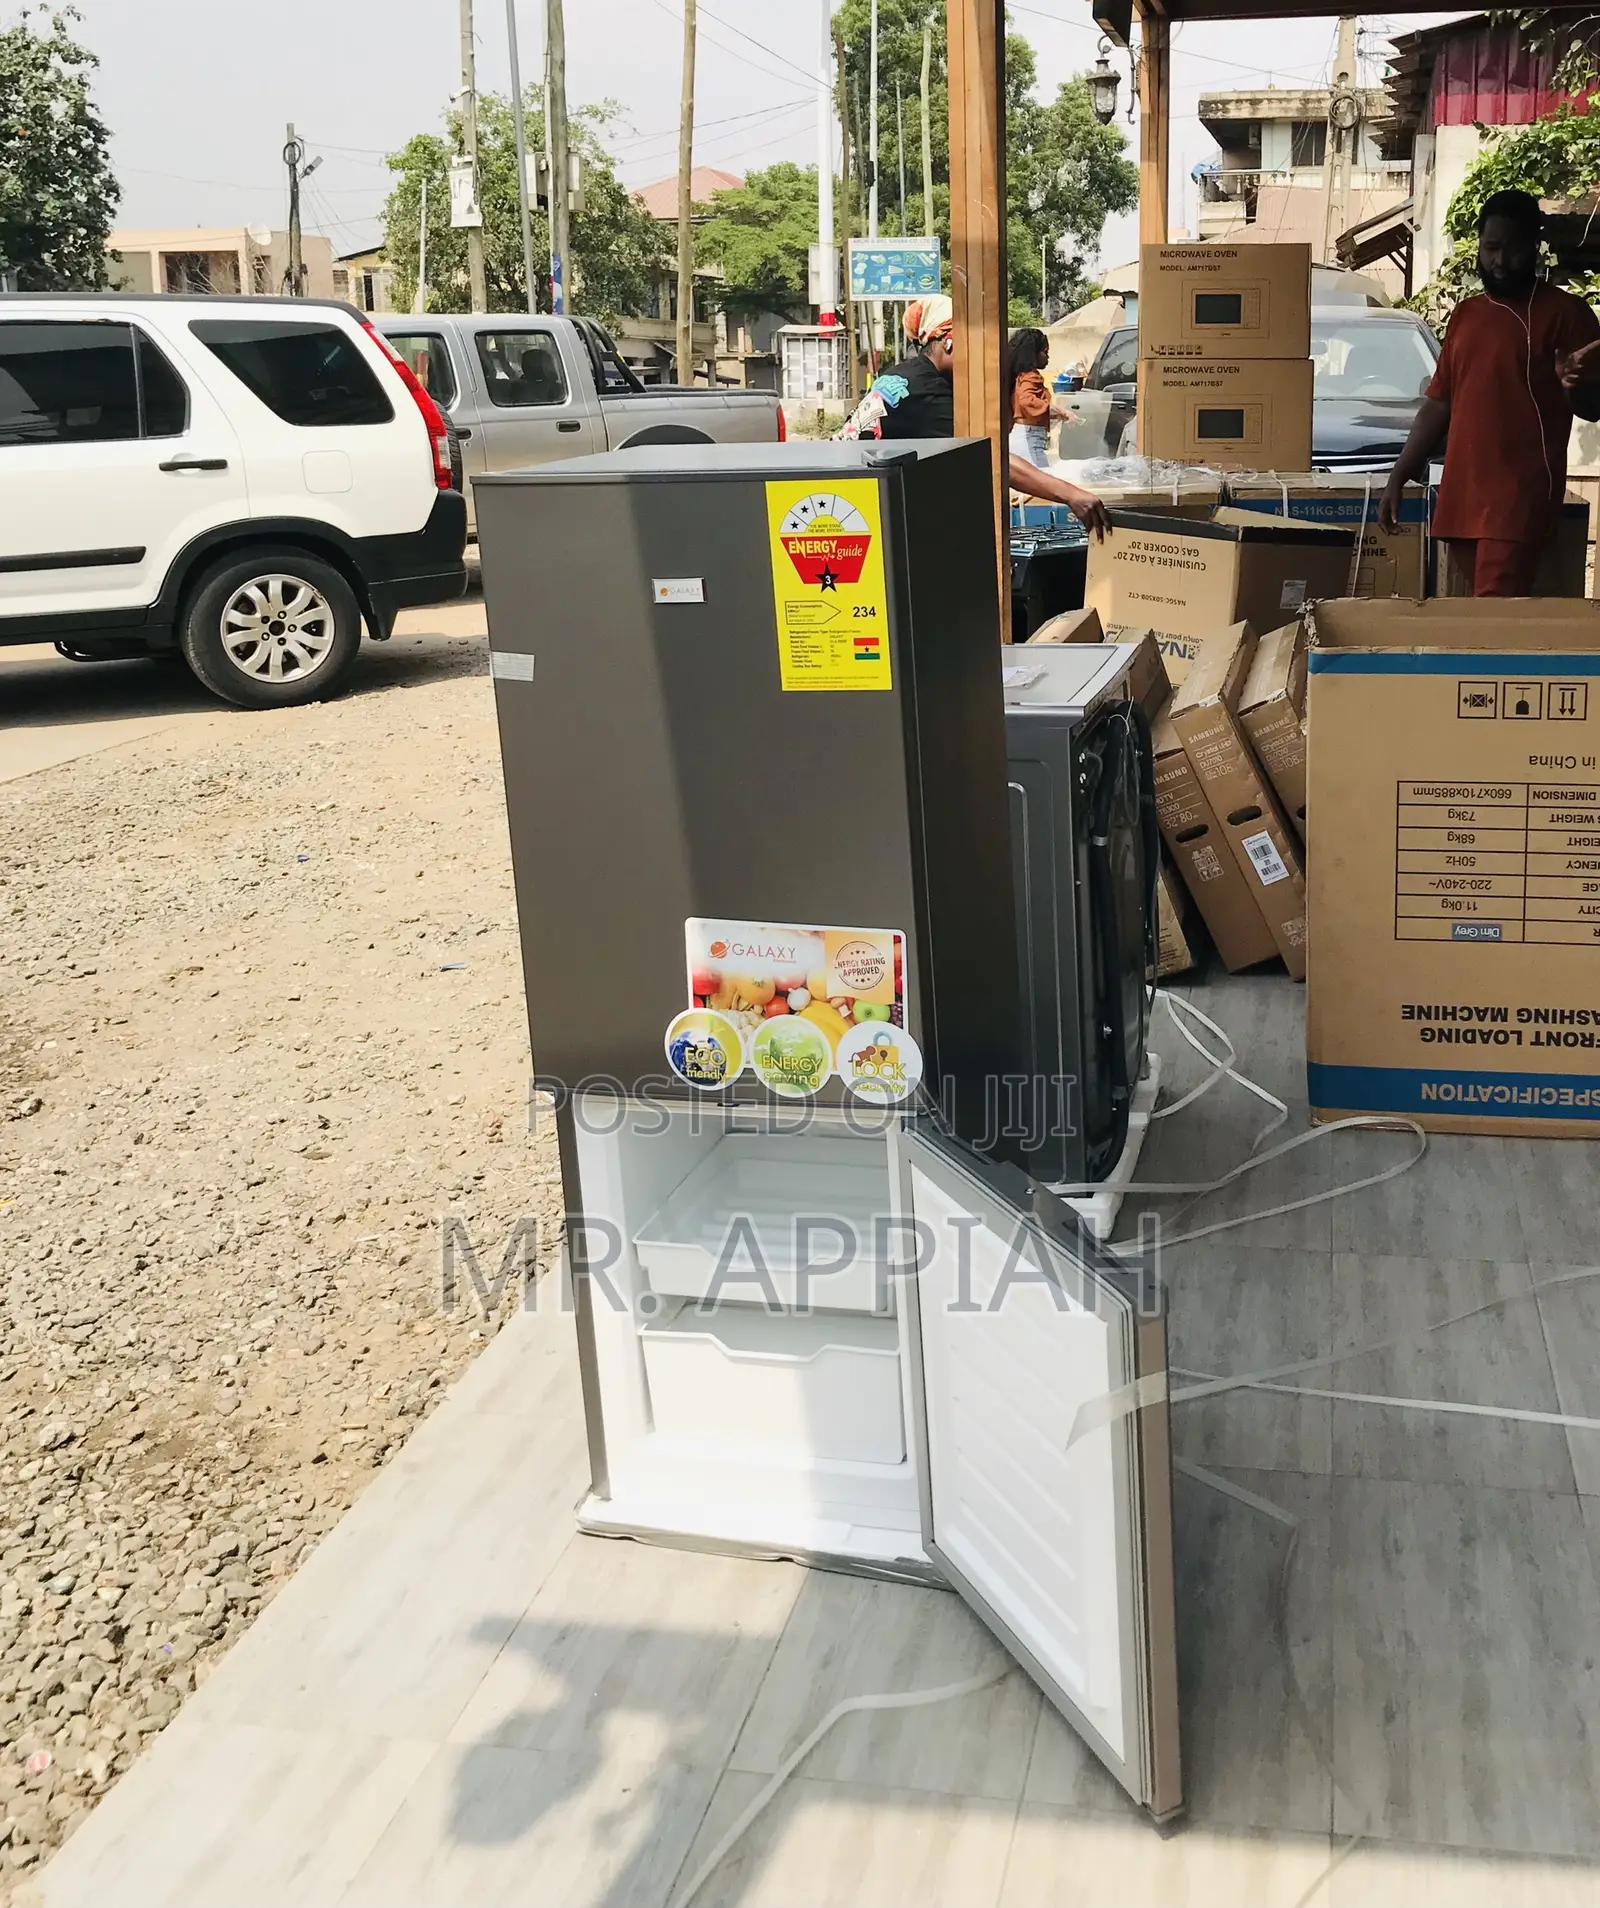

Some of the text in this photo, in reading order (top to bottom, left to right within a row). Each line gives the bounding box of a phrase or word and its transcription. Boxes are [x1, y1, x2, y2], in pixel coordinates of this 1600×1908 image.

[1160, 250, 1238, 258] MICROWAVE OVEN
[1163, 366, 1240, 374] MICROWAVE OVEN
[788, 538, 863, 560] ENERGY guide
[1143, 542, 1180, 554] COOKER
[1182, 547, 1200, 557] GAS
[1129, 552, 1147, 563] GAZ
[1149, 555, 1155, 566] À
[1157, 556, 1206, 571] CUISINIÈRE
[825, 575, 832, 585] 3
[853, 606, 876, 618] 234
[1165, 632, 1182, 641] pour
[1188, 724, 1225, 744] SAMSUNG
[1253, 717, 1290, 738] SAMSUNG
[1195, 745, 1219, 760] Crystal
[1529, 755, 1596, 770] in China
[1413, 787, 1512, 799] 660x710x885mm
[1532, 790, 1597, 801] DIMENSION
[1448, 808, 1476, 822] 73kg
[1549, 813, 1595, 824] WEIGHT
[1447, 831, 1475, 844] 68kg
[1445, 855, 1476, 867] 50Hz
[1429, 879, 1492, 891] 220-240V~
[1441, 898, 1478, 911] 11.0kg
[1454, 925, 1500, 937] Dim Grey
[731, 943, 796, 959] GALAXY
[860, 957, 886, 966] RATING
[843, 966, 880, 977] APPROVED
[1401, 1004, 1509, 1023] MACHINE
[1420, 1027, 1523, 1046] LOADING
[684, 1046, 727, 1067] ECO
[762, 1054, 823, 1073] ENERGY
[851, 1058, 908, 1081] LOCK
[686, 1067, 728, 1083] friendly
[763, 1070, 820, 1089] saving
[851, 1079, 906, 1096] security
[1421, 1082, 1600, 1107] SPECIFICATION
